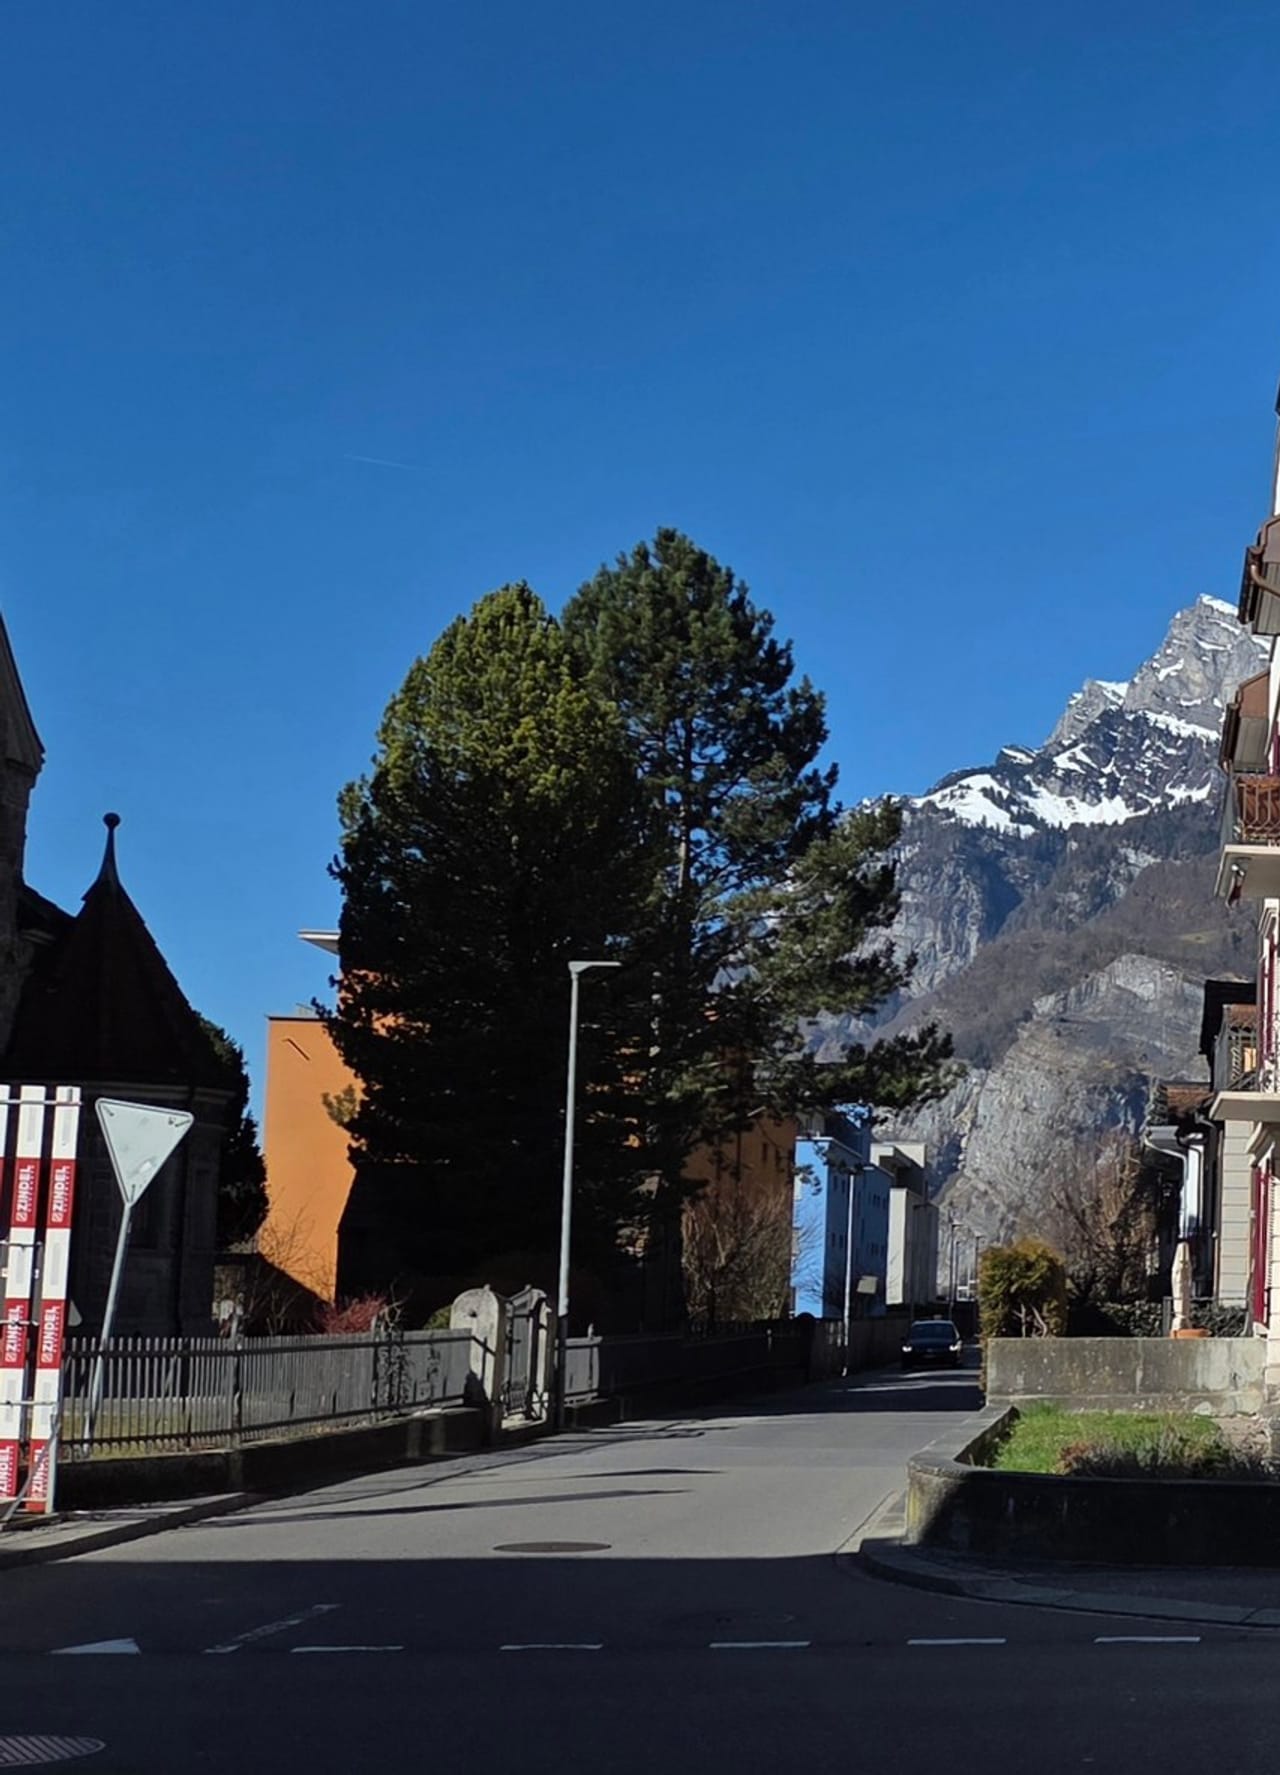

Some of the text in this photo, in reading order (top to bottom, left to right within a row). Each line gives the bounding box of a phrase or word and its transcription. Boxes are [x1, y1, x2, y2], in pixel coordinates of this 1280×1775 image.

[16, 1165, 31, 1212] ZINDEL
[52, 1166, 67, 1212] ZINDEL
[42, 1306, 57, 1352] ZINDEL
